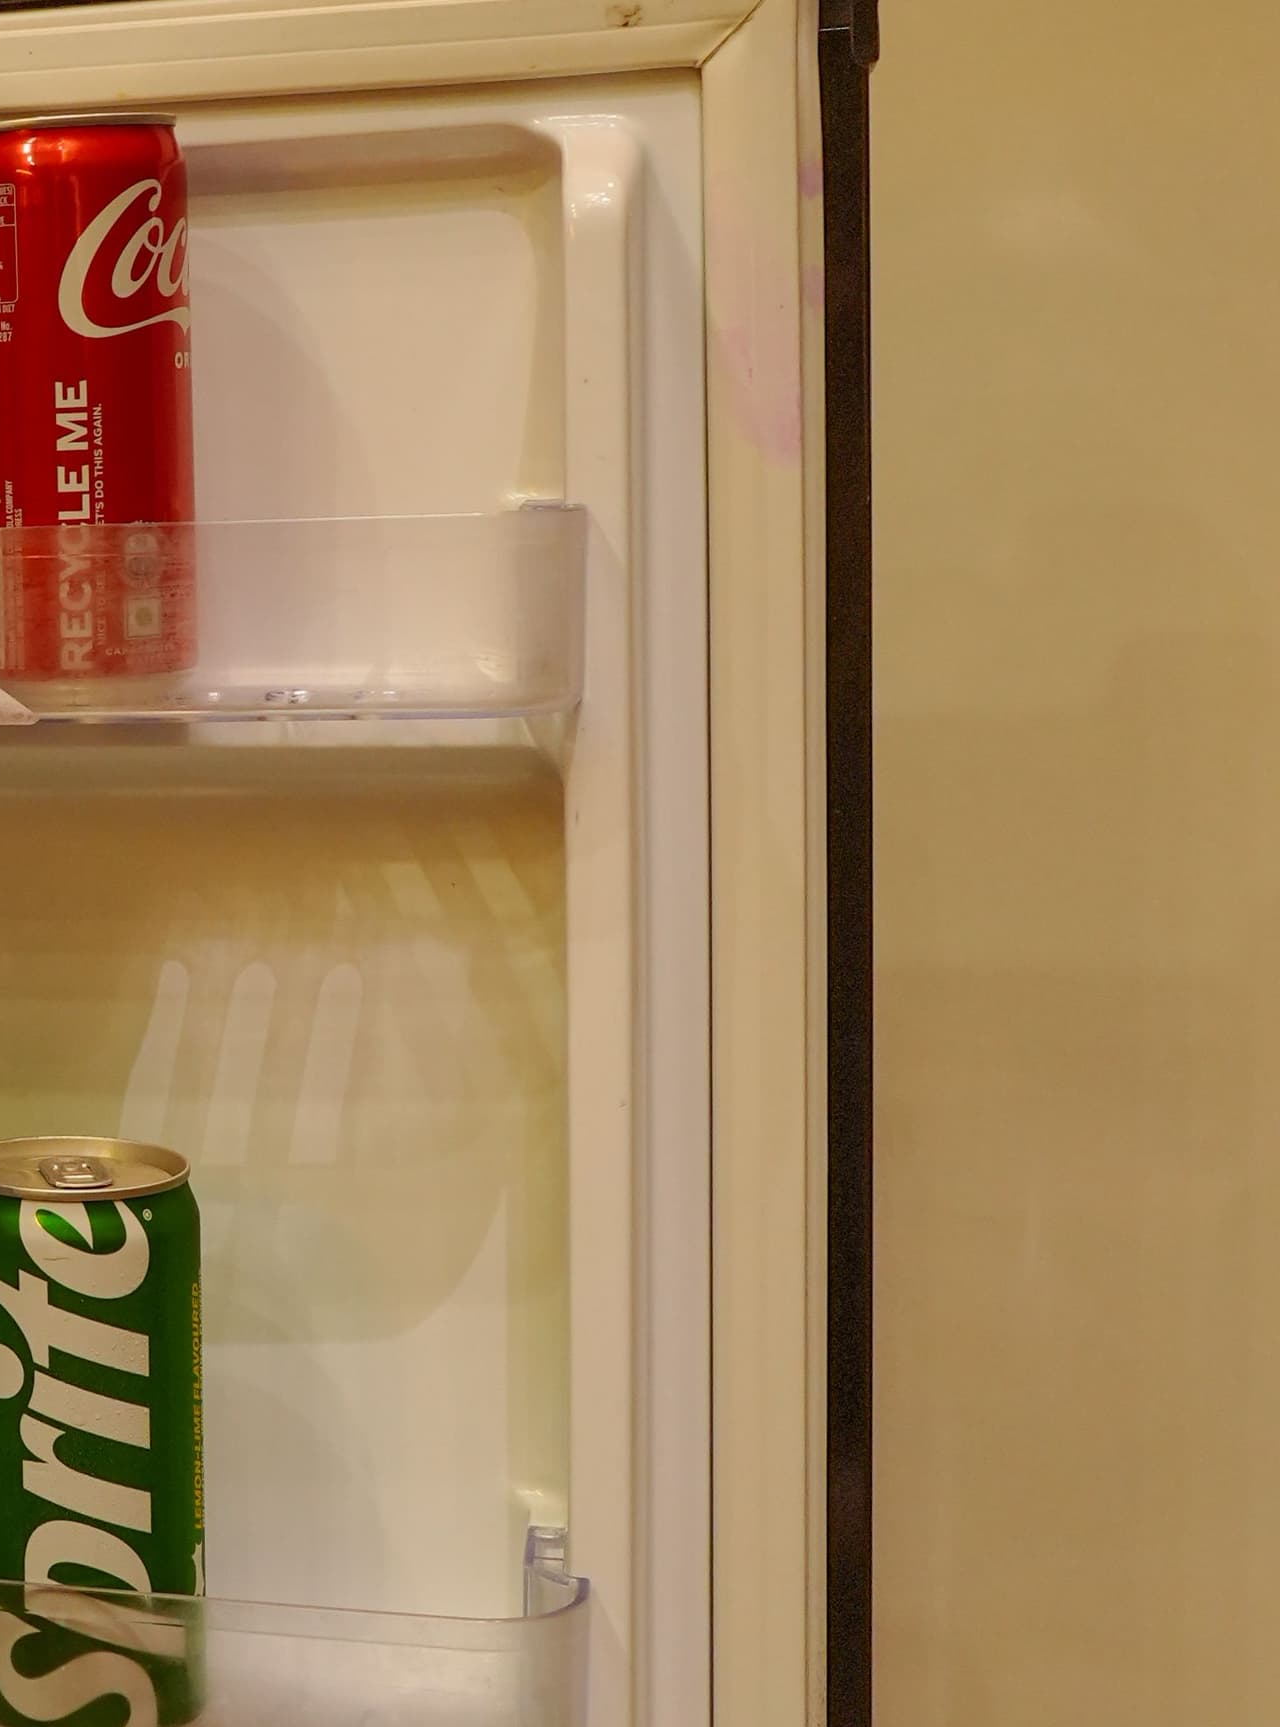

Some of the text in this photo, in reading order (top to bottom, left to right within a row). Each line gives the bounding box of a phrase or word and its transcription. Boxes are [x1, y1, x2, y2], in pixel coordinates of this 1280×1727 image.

[92, 403, 103, 446] AGAIN.
[93, 447, 104, 478] THIS
[94, 480, 104, 498] DO
[55, 380, 92, 671] RECYCLE ME
[192, 1281, 205, 1530] LEMON-LIME FLAVOURED
